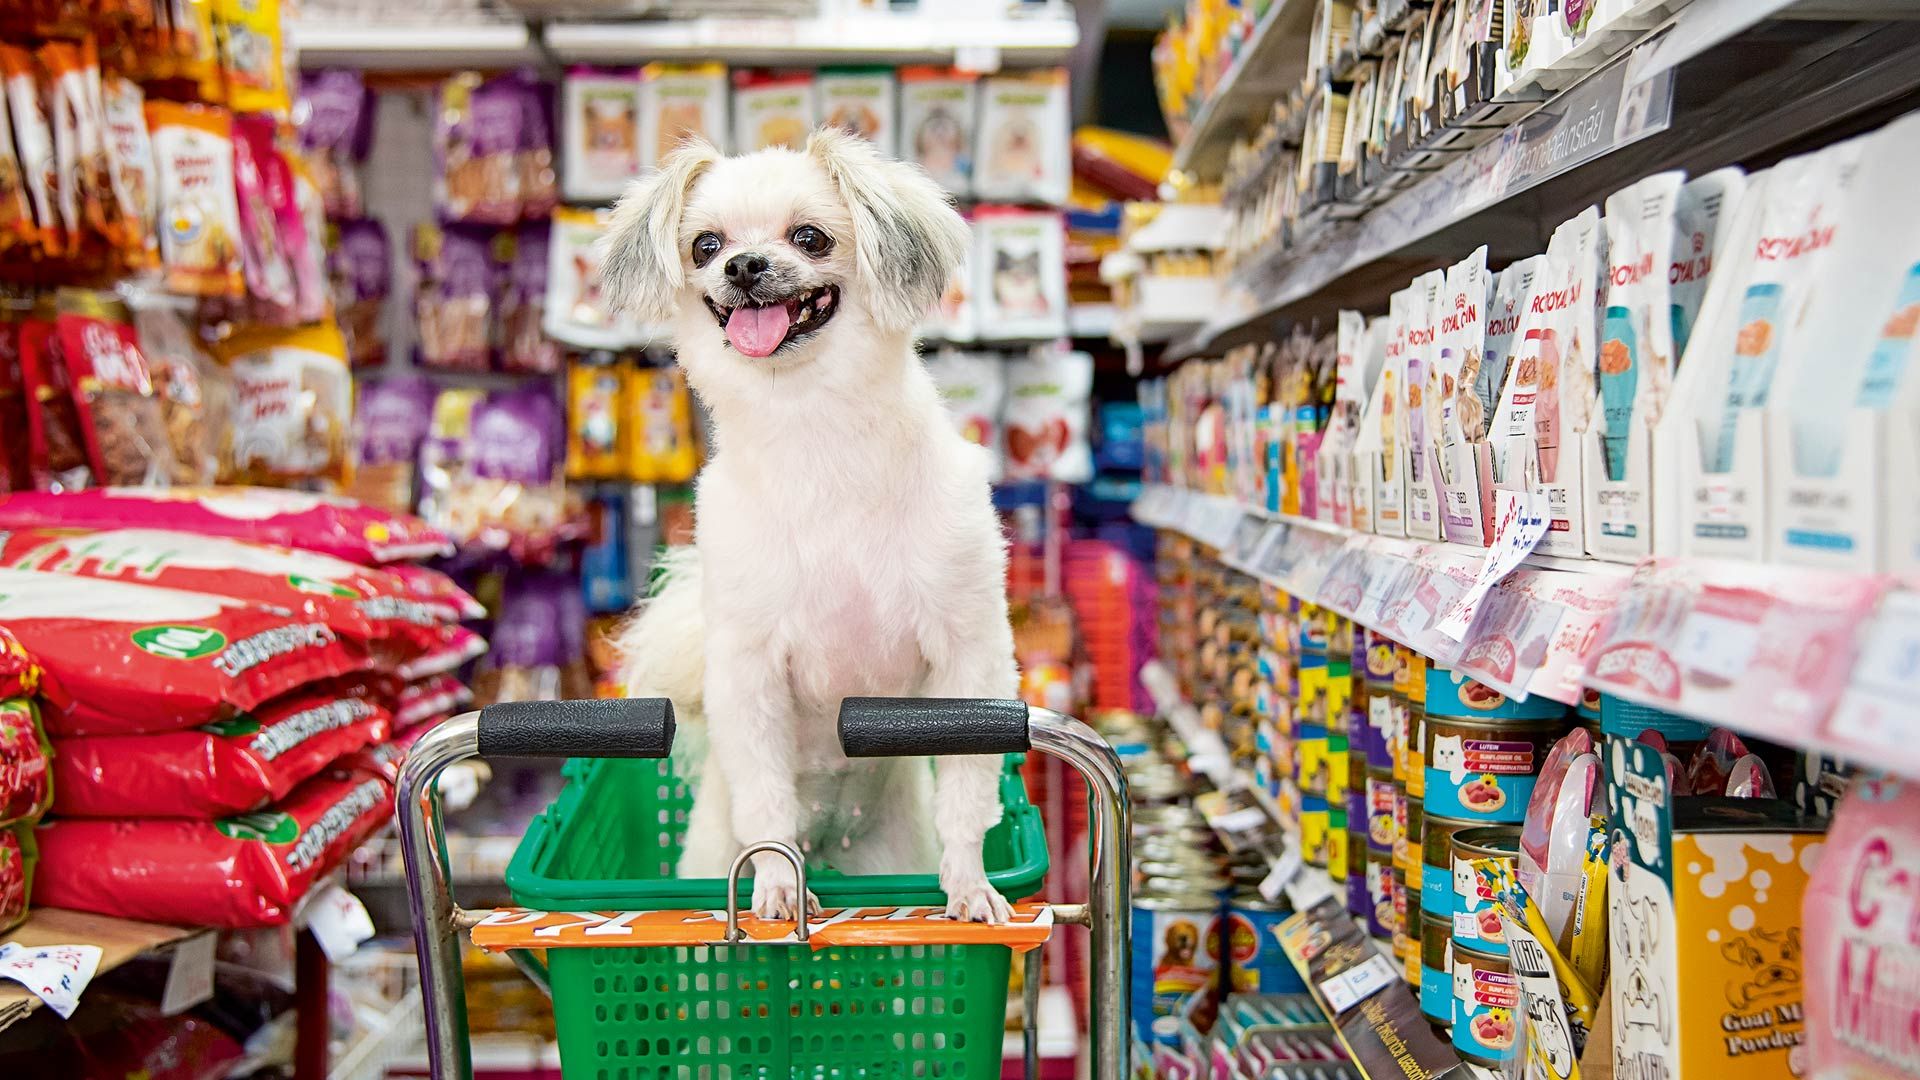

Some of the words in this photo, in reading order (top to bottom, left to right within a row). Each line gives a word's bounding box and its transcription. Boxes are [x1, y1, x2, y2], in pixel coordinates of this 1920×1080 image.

[1479, 743, 1500, 751] LUTEIN
[1480, 753, 1513, 761] SUNFLOWER
[1722, 1009, 1773, 1032] Goat
